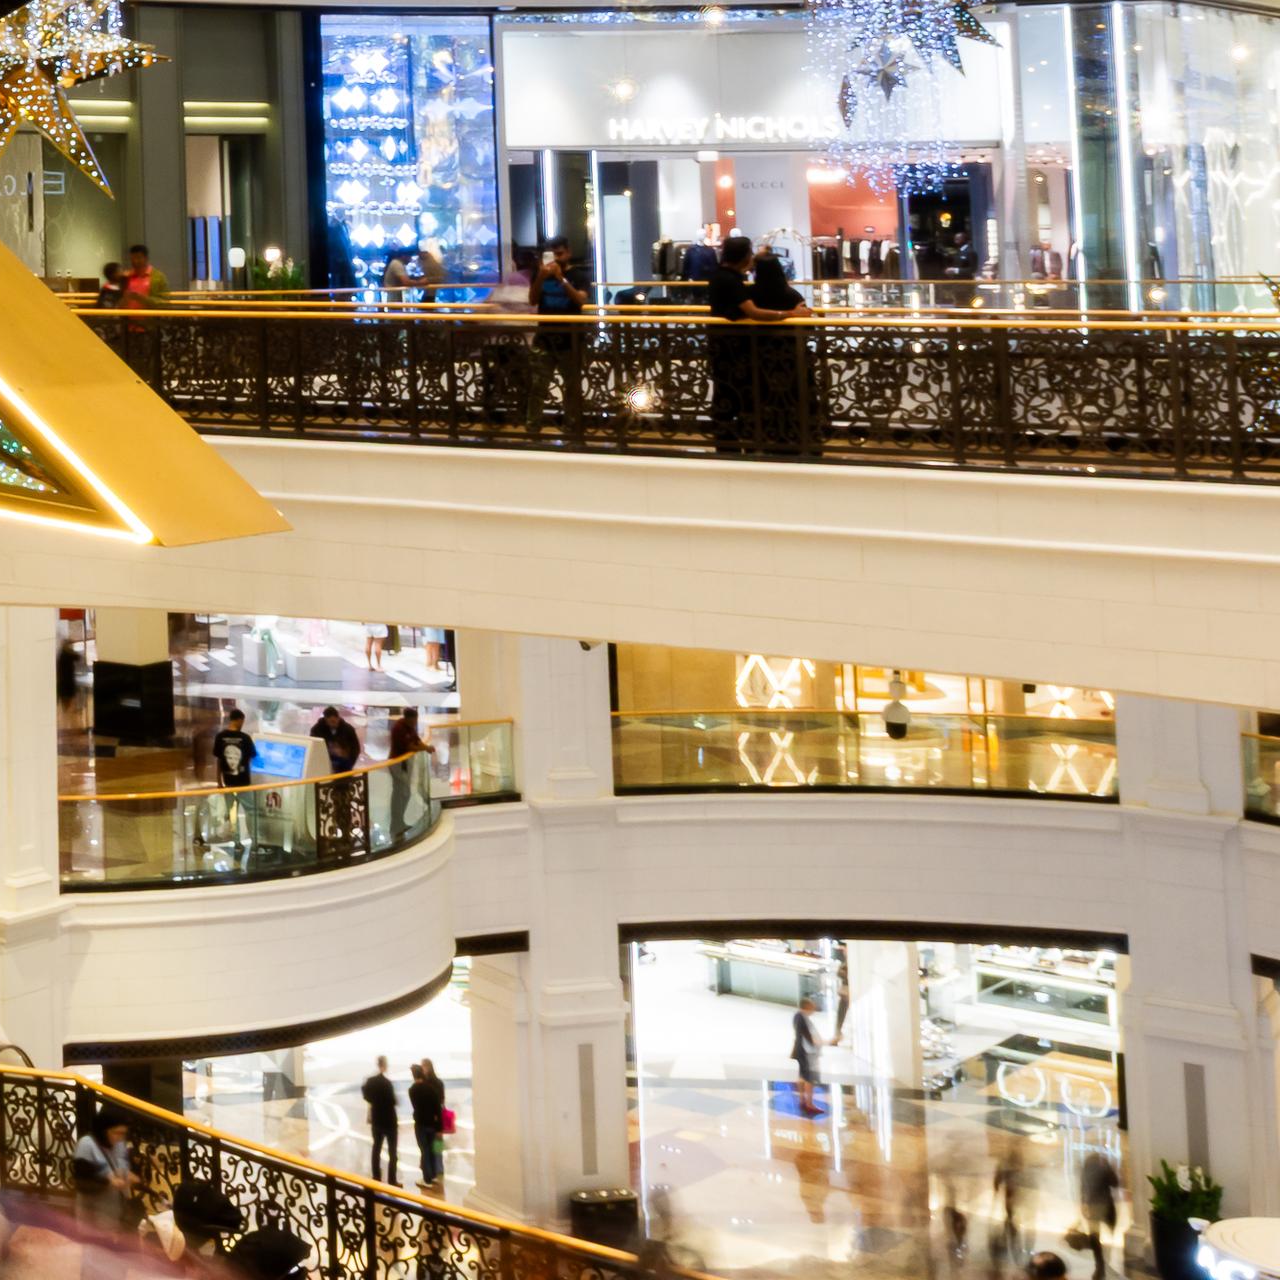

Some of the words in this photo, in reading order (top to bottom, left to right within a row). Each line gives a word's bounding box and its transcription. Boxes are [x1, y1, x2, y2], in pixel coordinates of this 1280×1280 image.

[608, 118, 709, 140] HARVEY
[716, 117, 841, 140] NICHOLS
[741, 180, 784, 190] GUCCI
